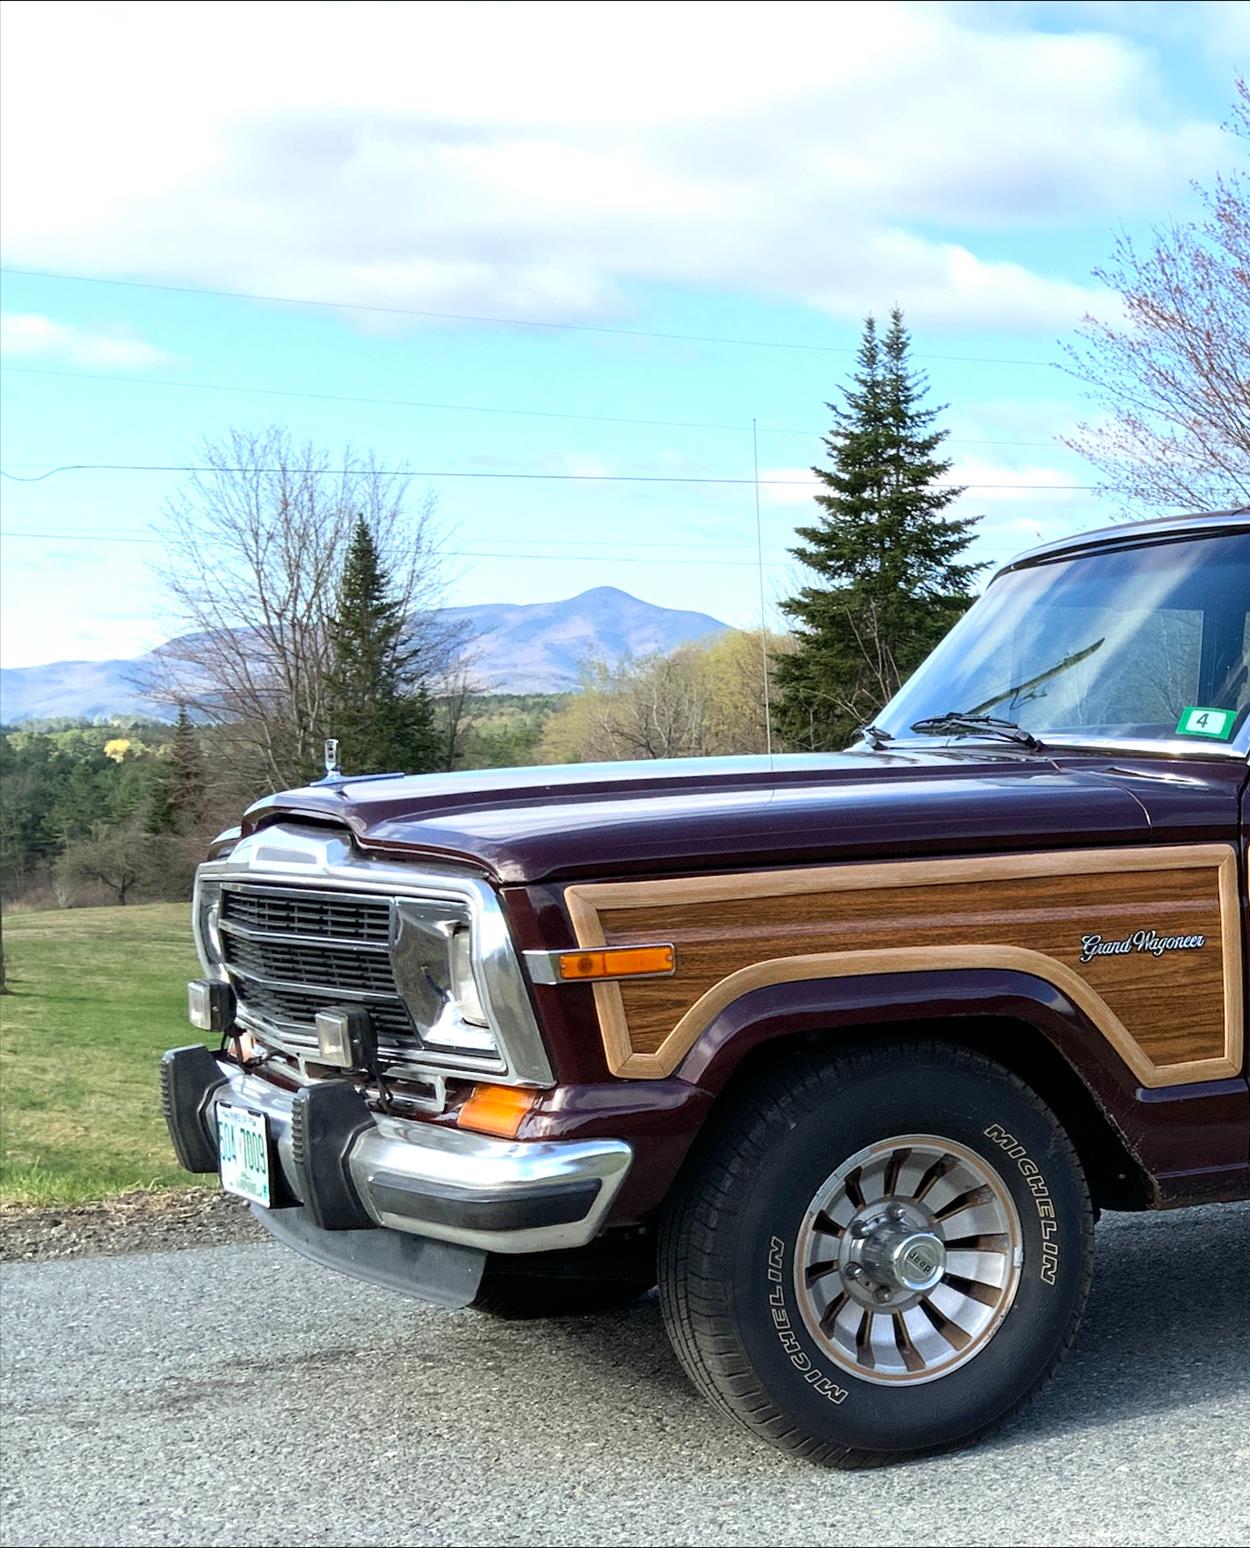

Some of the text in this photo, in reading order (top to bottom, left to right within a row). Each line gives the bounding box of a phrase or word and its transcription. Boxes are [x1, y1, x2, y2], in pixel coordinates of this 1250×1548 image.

[1196, 713, 1209, 728] 4
[1080, 930, 1204, 962] Grand Wagoneer
[240, 1127, 267, 1176] 7009
[984, 1124, 1058, 1286] MICHELIN
[908, 1252, 932, 1273] Jeep
[768, 1236, 849, 1405] MICHELIN
